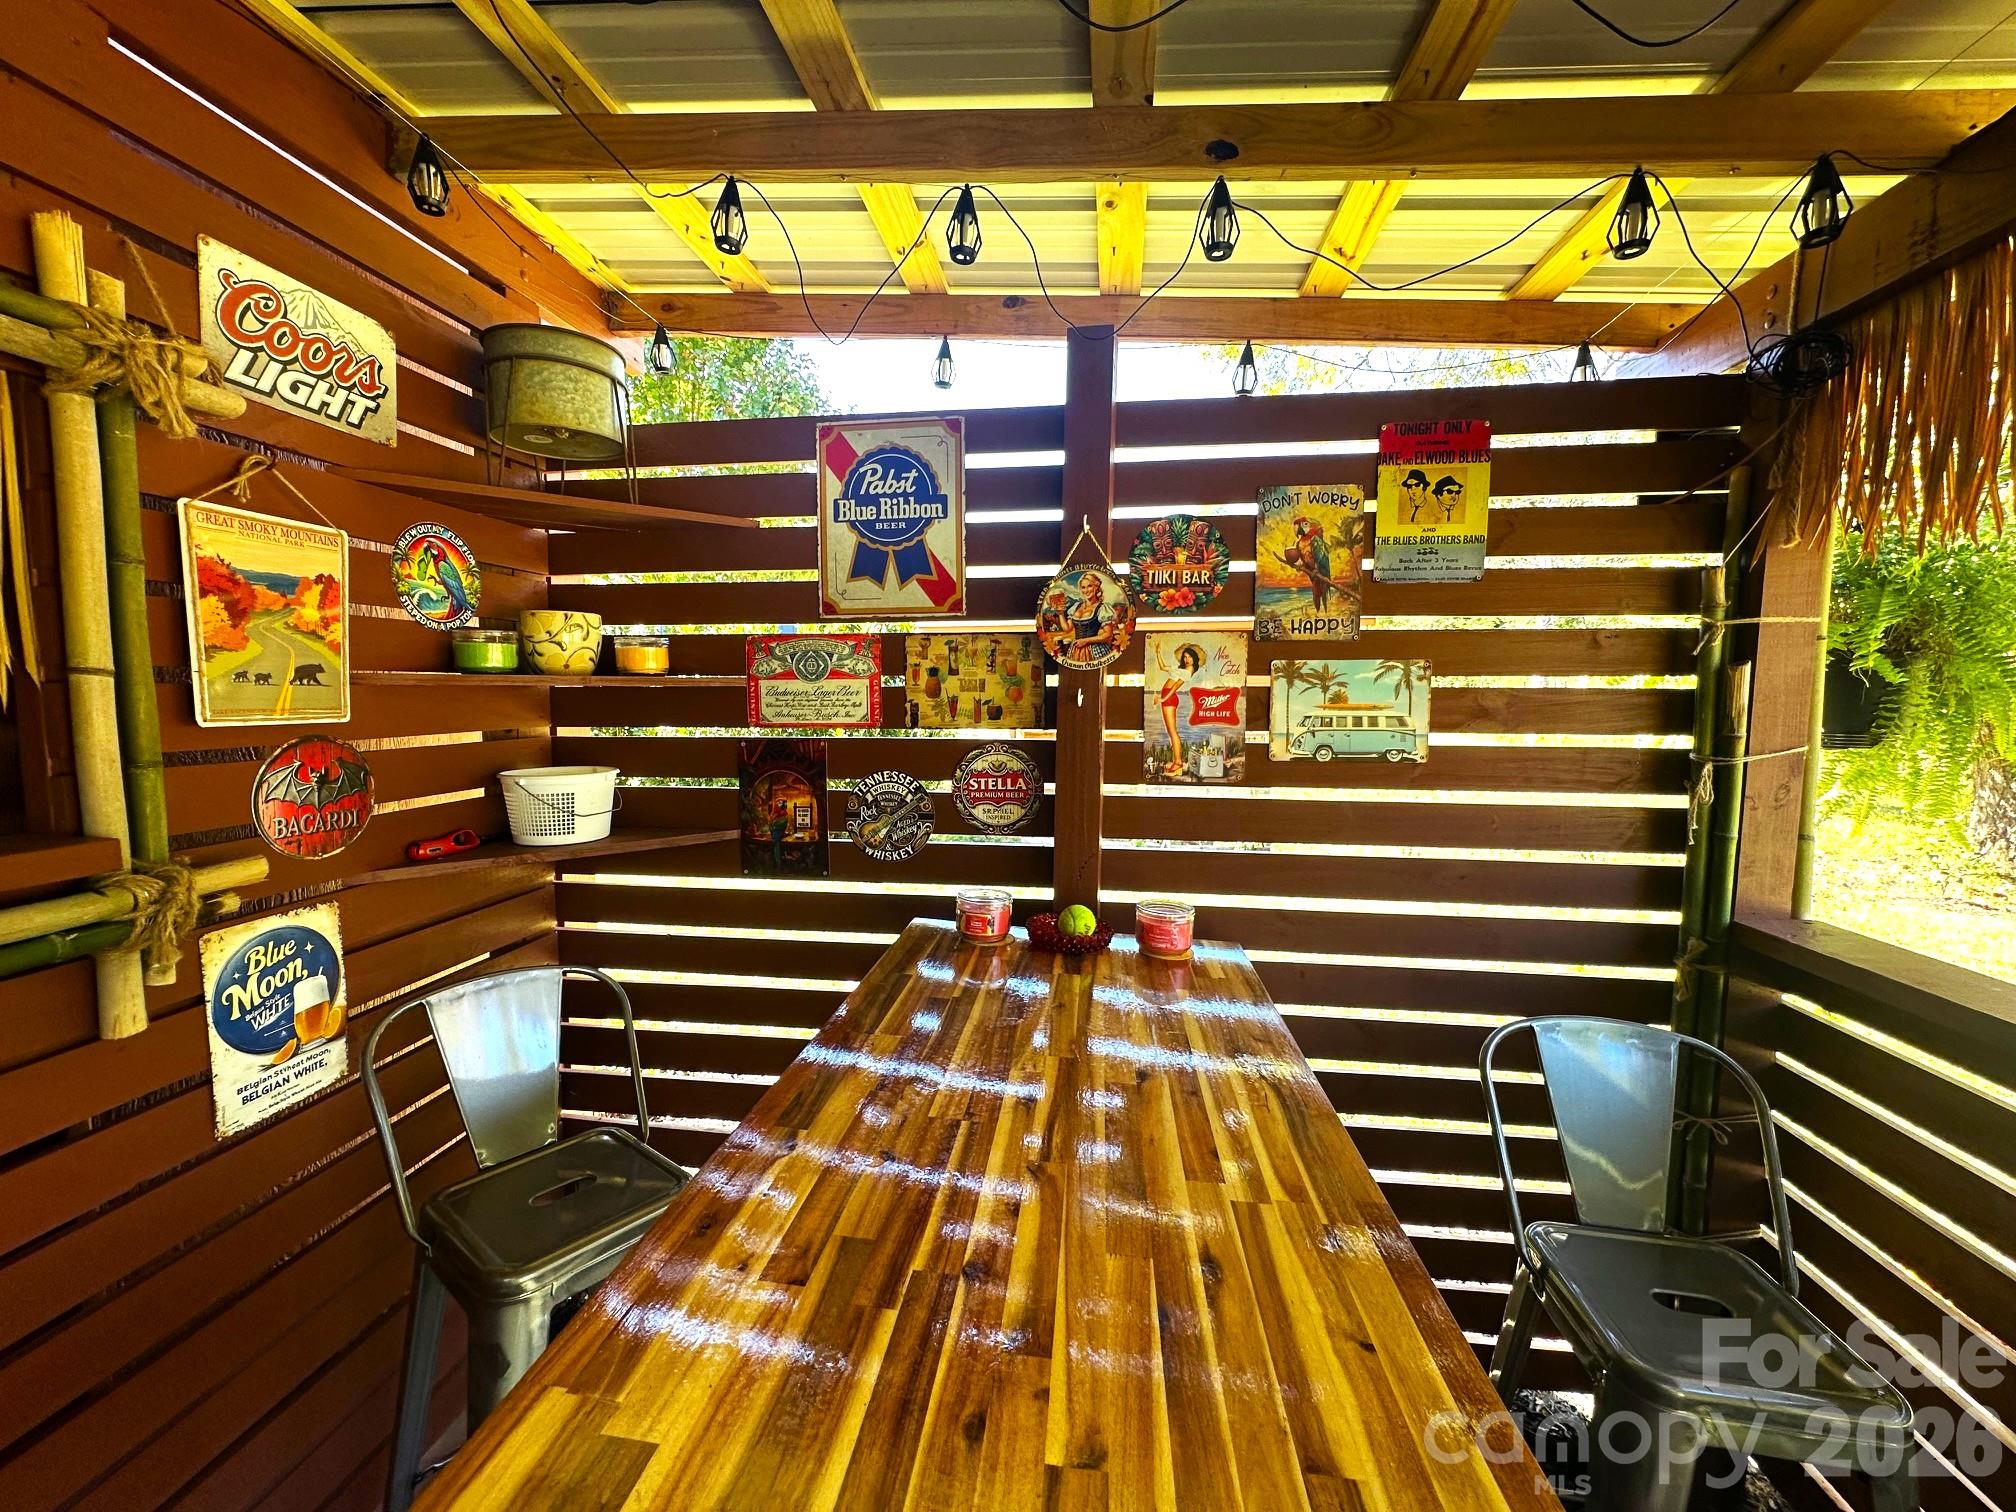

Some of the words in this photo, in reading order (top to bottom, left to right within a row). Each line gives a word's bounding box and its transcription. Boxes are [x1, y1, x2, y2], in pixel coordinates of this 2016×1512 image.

[215, 268, 389, 398] Coors
[224, 348, 381, 429] LIGHT
[1394, 421, 1438, 436] TONIGHT
[1443, 420, 1472, 434] ONLY
[1414, 450, 1455, 464] ELWOOD
[1459, 449, 1491, 463] BLUES
[859, 463, 919, 495] Pabst
[837, 500, 877, 521] Blue
[879, 498, 944, 520] Ribbon
[1262, 492, 1302, 513] DON'T
[1308, 491, 1360, 510] WORRY
[196, 511, 236, 528] GREAT
[238, 519, 278, 535] SMOKY
[281, 527, 339, 548] MOUNTAINS
[875, 522, 906, 530] BEER
[239, 530, 282, 544] NATIONAL
[285, 538, 305, 548] PARK
[417, 525, 432, 534] OUT
[432, 525, 444, 535] MY
[447, 531, 464, 547] FLIP
[1376, 536, 1391, 545] THE
[1393, 536, 1418, 545] BLUES
[1420, 535, 1462, 545] BROTHERS
[1463, 534, 1485, 544] BAND
[1182, 570, 1210, 584] BAR
[427, 620, 438, 629] ON
[446, 620, 461, 630] POP
[1258, 619, 1282, 635] BE
[1290, 616, 1354, 635] HAPPY
[1214, 646, 1230, 661] Nice
[1219, 660, 1241, 676] Catch
[765, 685, 808, 697] Budweiser
[811, 685, 837, 698] Lager
[836, 685, 861, 697] Beer
[1199, 694, 1231, 708] Miller
[853, 771, 919, 797] TENNESSEE
[873, 783, 906, 795] WHISKEY
[969, 778, 1027, 790] STELLA
[861, 805, 878, 820] Rock
[273, 808, 360, 839] BACARDI
[865, 844, 914, 861] WHISKEY
[245, 937, 297, 976] Blue
[251, 993, 291, 1030] WHITE
[242, 1075, 290, 1105] BELGIAN
[294, 1058, 328, 1080] WHITE.
